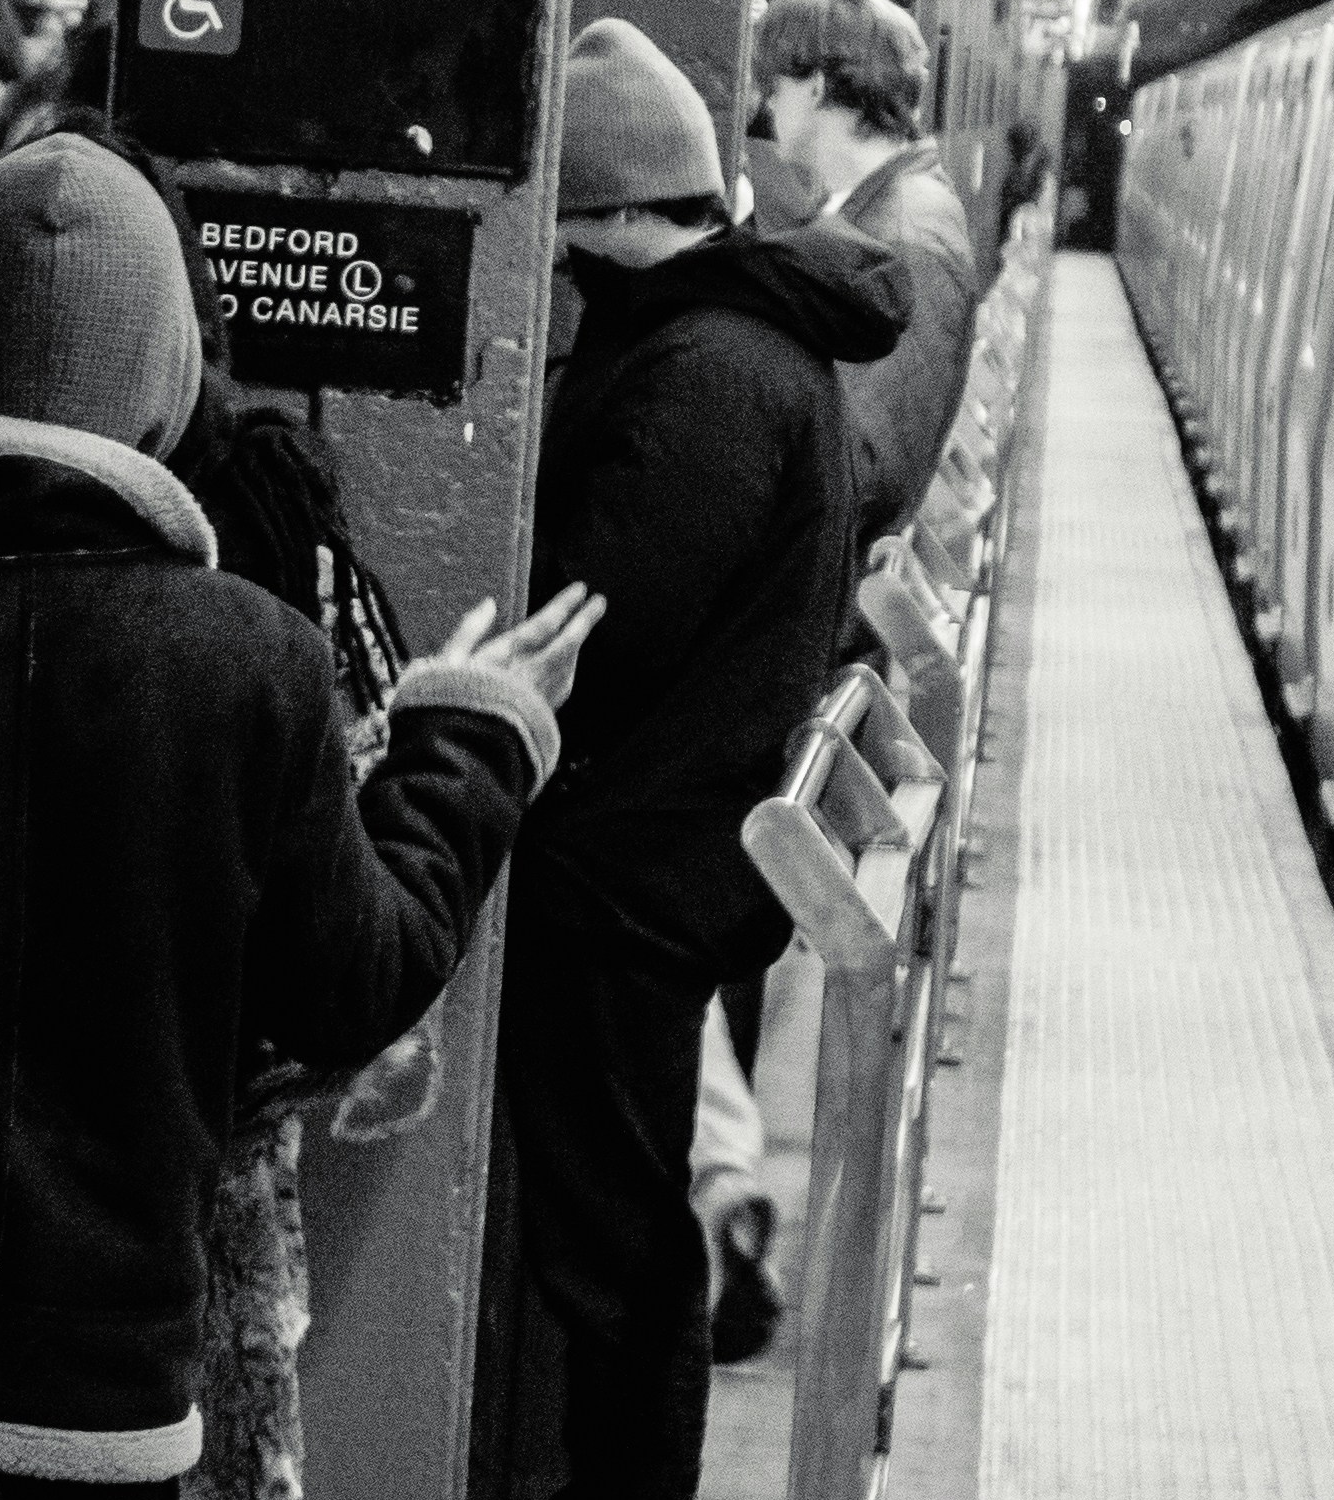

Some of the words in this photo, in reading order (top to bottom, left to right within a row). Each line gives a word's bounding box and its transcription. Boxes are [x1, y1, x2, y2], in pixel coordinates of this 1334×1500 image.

[200, 222, 359, 259] BEDFORD
[218, 293, 239, 319] O
[251, 296, 421, 333] CANARSIE
